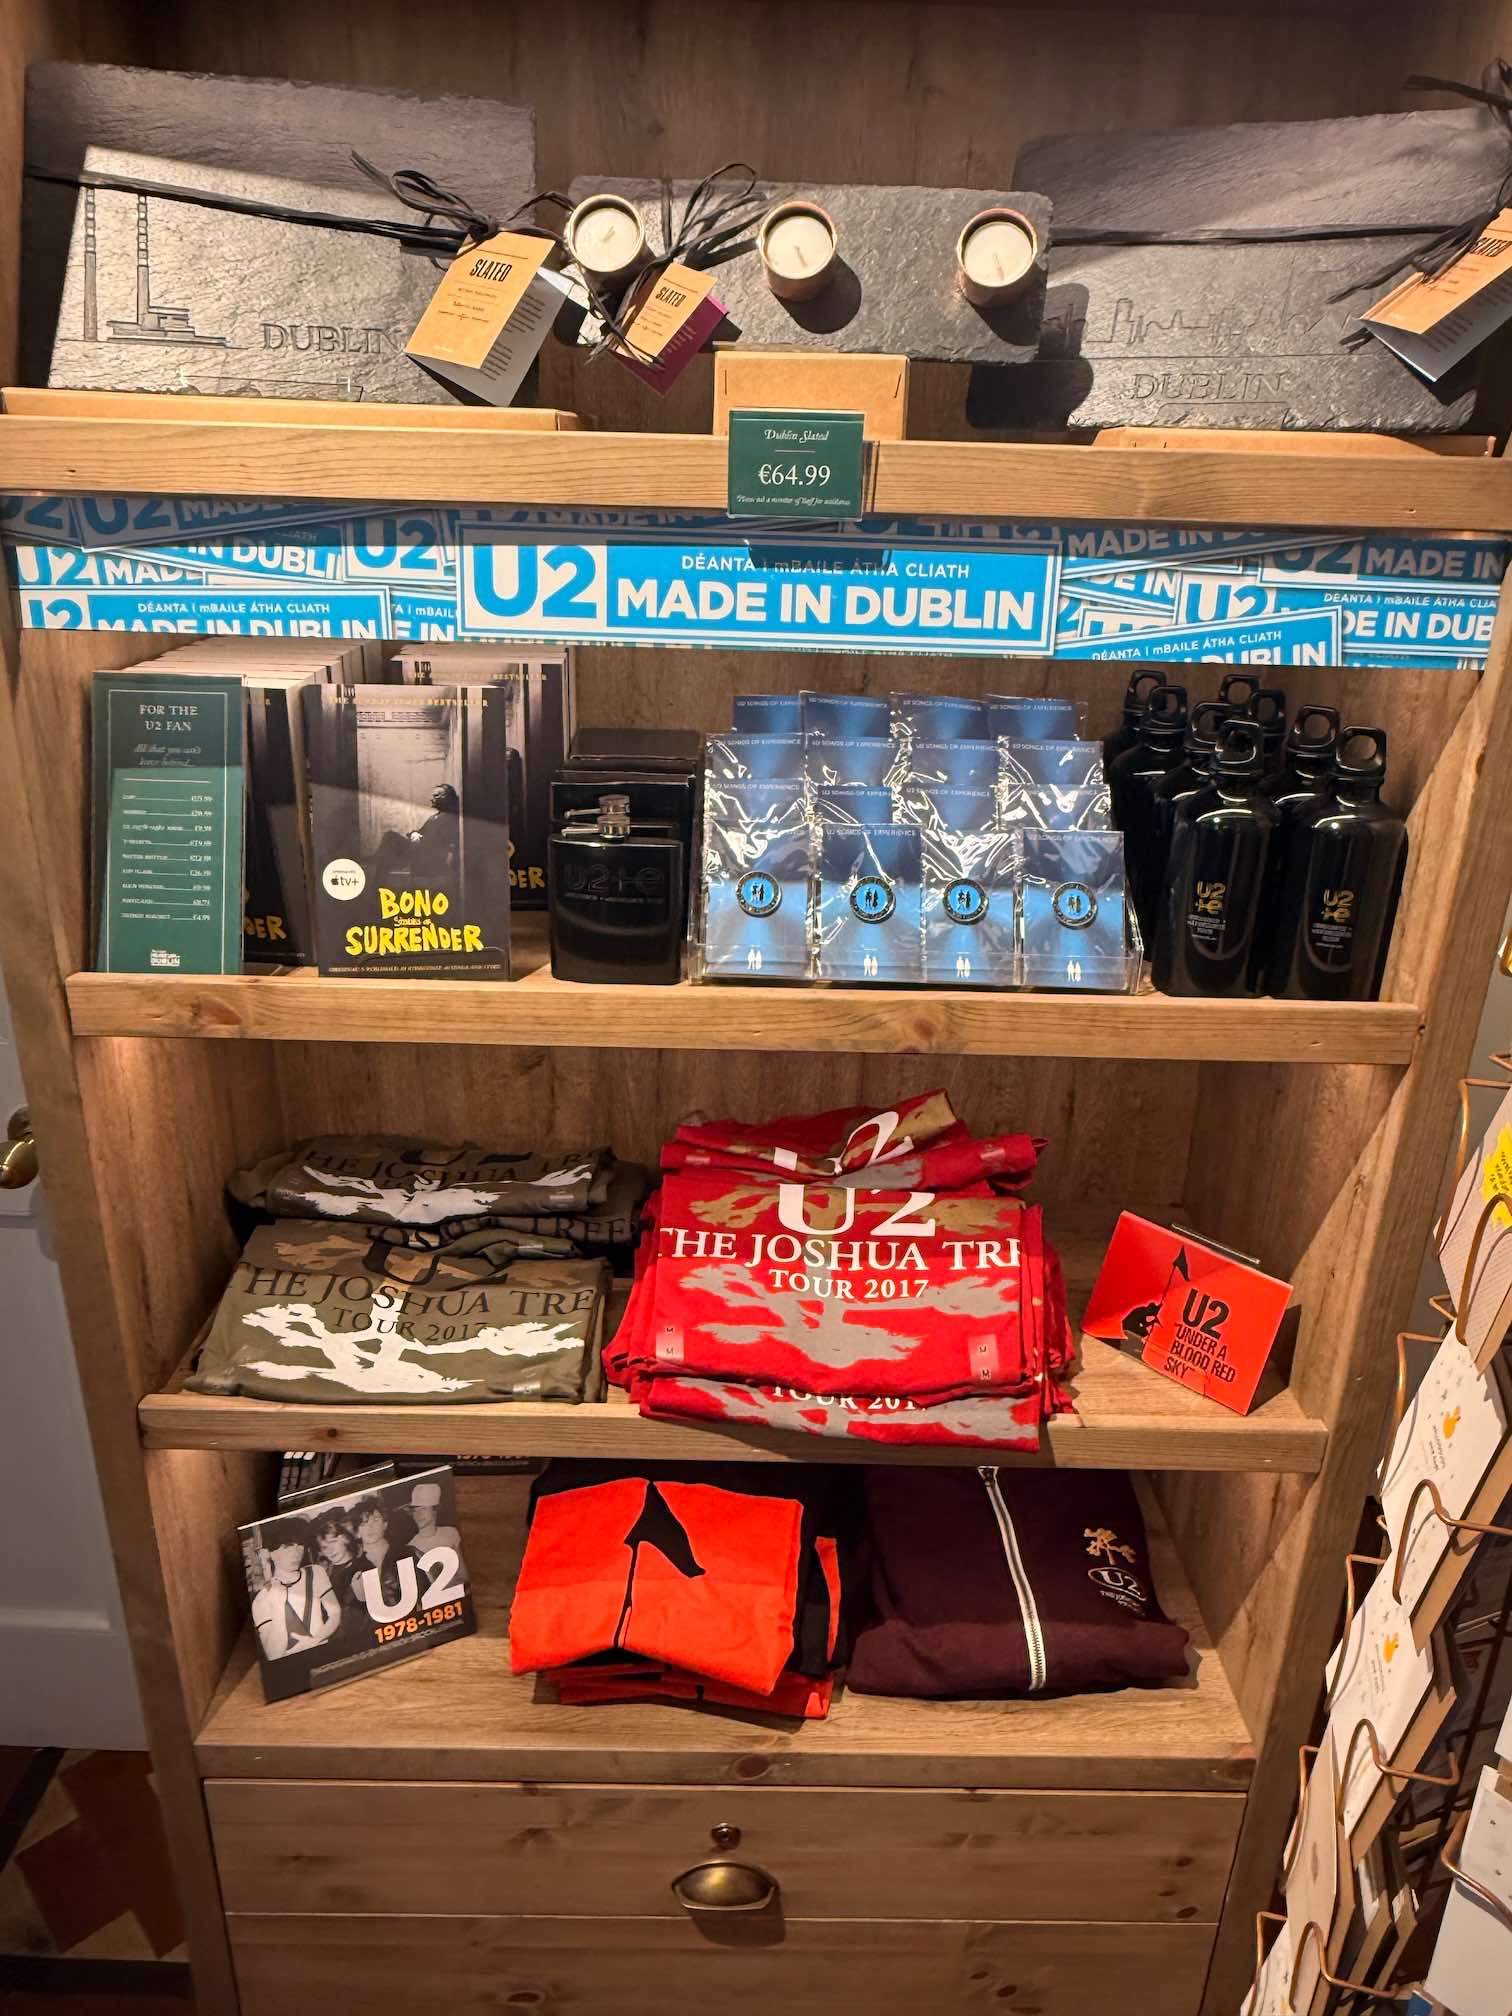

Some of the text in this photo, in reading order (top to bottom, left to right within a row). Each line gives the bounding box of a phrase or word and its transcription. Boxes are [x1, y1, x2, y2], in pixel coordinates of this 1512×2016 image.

[469, 258, 513, 282] SLATED
[655, 286, 687, 308] SLATED
[260, 322, 405, 354] DUBLIN
[1132, 372, 1290, 400] DUBLIN
[758, 463, 832, 487] €64.99
[353, 516, 438, 569] U2
[1068, 527, 1171, 561] MADE
[682, 553, 756, 572] DÉANTA
[905, 562, 970, 578] CLIATH
[1366, 548, 1466, 578] MADE
[472, 543, 599, 619] U2
[617, 578, 767, 622] MADE
[780, 583, 832, 624] IN
[845, 586, 1035, 630] DUBLIN
[287, 603, 330, 613] CLIATH
[1186, 582, 1268, 623] U2
[1239, 630, 1282, 646] CLIATH
[1384, 611, 1421, 639] IN
[139, 704, 198, 716] FOR THE
[145, 720, 192, 731] U2 FAN
[340, 875, 359, 886] tv+
[1195, 881, 1226, 898] U2
[378, 887, 449, 919] BONO
[1323, 889, 1354, 907] U2
[345, 923, 484, 956] SURRENDER
[777, 1184, 937, 1237] U2
[745, 1234, 928, 1271] JOSHUA
[314, 1273, 490, 1317] JOSHUA
[768, 1269, 930, 1300] TOUR 2017
[333, 1307, 415, 1338] TOUR
[1183, 1288, 1230, 1339] U2
[1170, 1340, 1237, 1384] BLOOD RED
[1216, 1346, 1227, 1362] A
[868, 1395, 925, 1412] 201
[361, 1546, 466, 1624] U2
[1099, 1570, 1141, 1596] U2
[374, 1601, 463, 1644] 1978-1981
